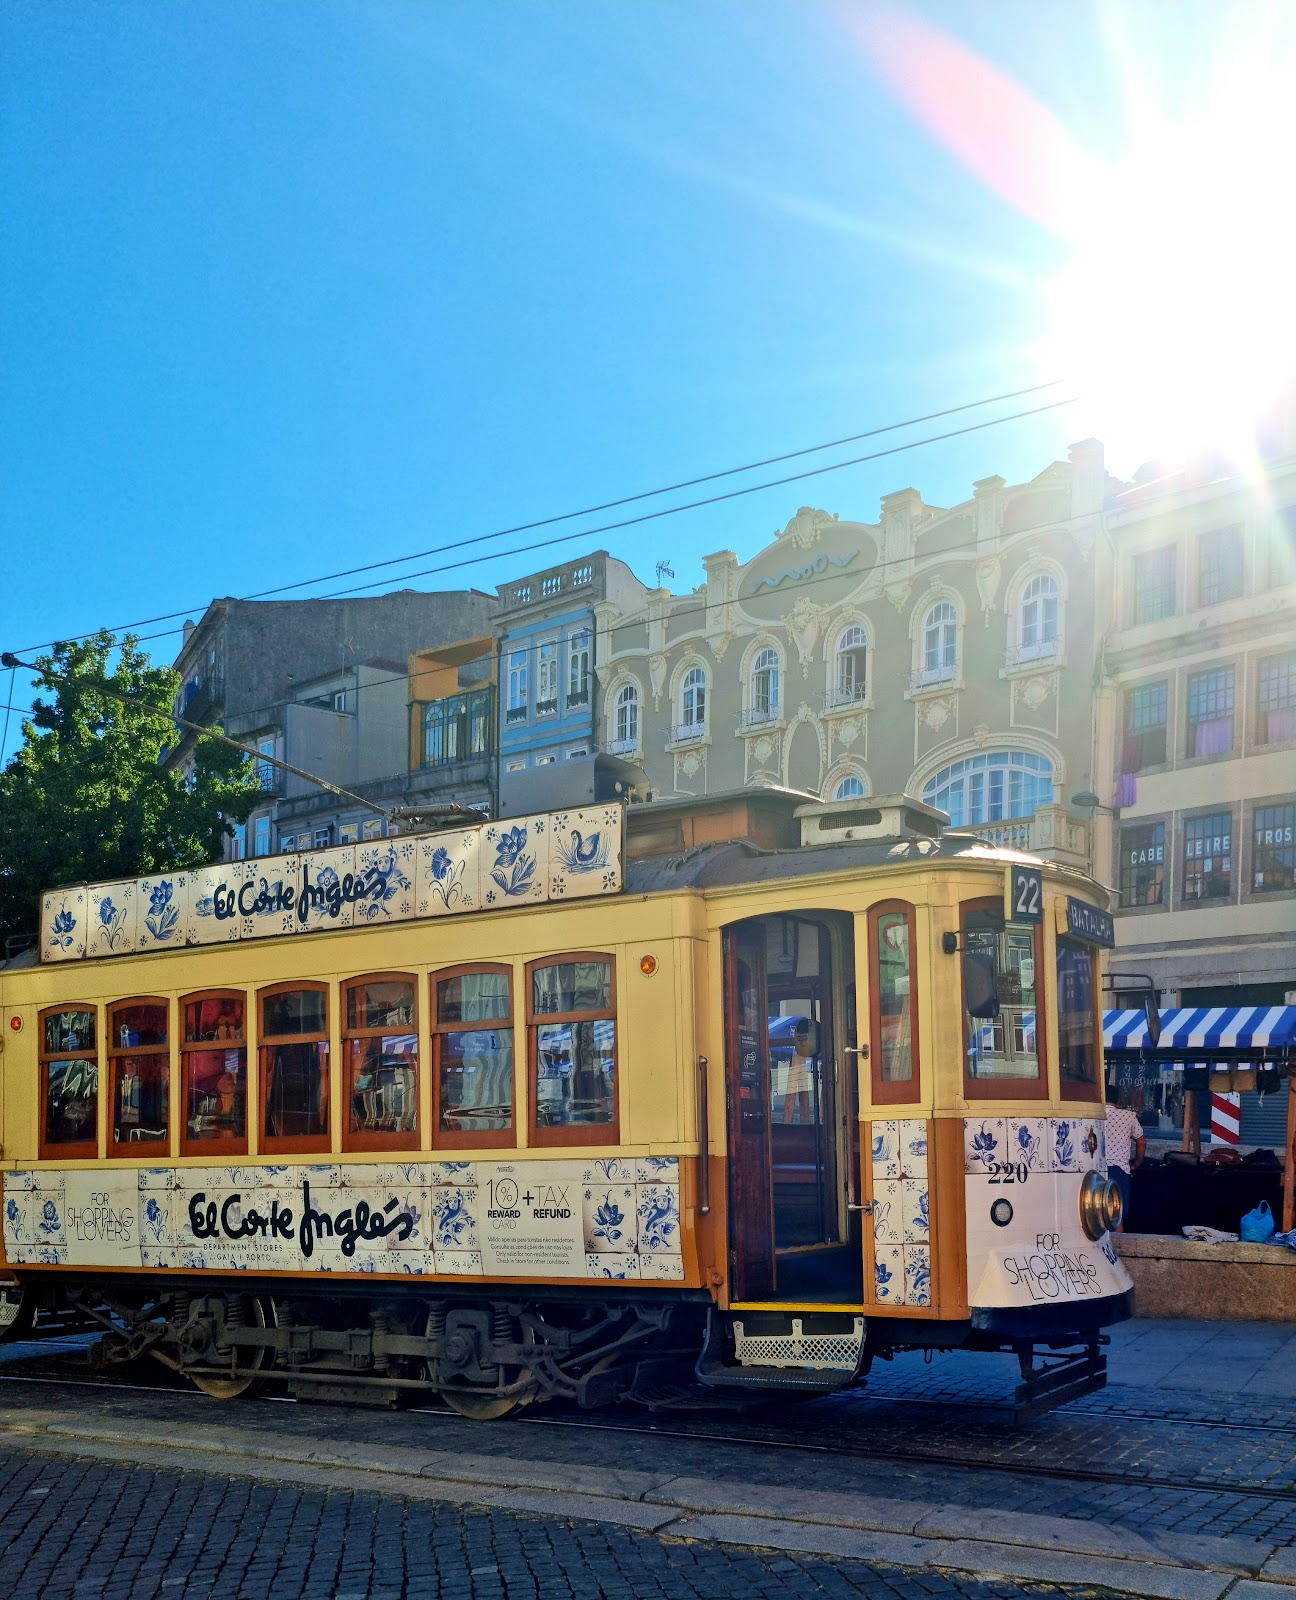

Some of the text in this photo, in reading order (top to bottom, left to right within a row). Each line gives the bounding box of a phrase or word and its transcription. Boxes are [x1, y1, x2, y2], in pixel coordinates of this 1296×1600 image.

[1131, 827, 1292, 864] CABE LEIRE IROS
[213, 864, 387, 923] El Corte Inglés
[1016, 875, 1039, 914] 22
[988, 1162, 1028, 1184] 220
[91, 1192, 109, 1206] FOR
[67, 1207, 134, 1228] SHOPPING
[188, 1181, 414, 1258] El Corte Inglés
[487, 1210, 521, 1219] REWARD
[492, 1219, 517, 1230] CARD
[533, 1209, 571, 1219] REFUND
[76, 1220, 131, 1242] LOVERS
[203, 1243, 283, 1252] DEPARTMENT STORES
[1036, 1233, 1061, 1252] FOR
[216, 1253, 271, 1261] GAIA PORTO
[1003, 1253, 1097, 1285] SHOPPING
[1024, 1269, 1102, 1301] LOVERS
